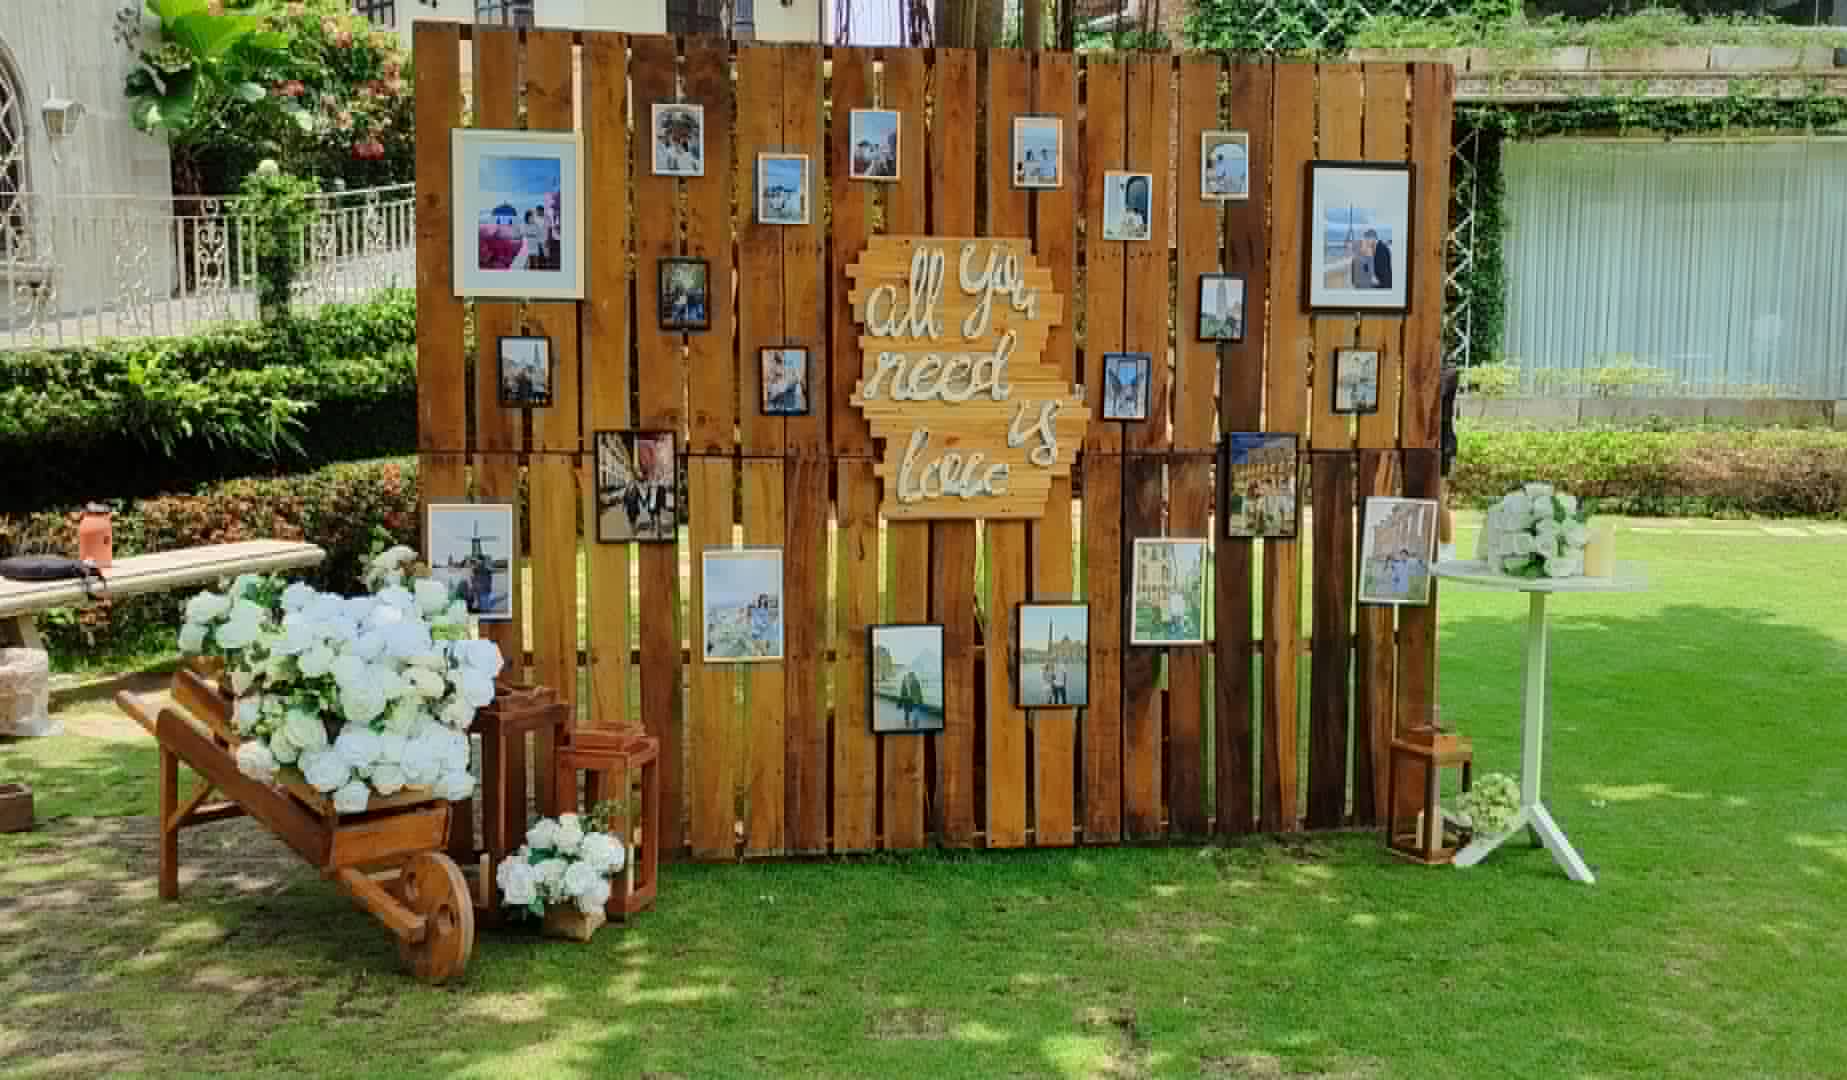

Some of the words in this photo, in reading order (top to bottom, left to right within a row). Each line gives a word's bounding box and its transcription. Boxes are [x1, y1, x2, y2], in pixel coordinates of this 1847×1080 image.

[865, 245, 945, 341] all
[863, 328, 1017, 404] need
[896, 424, 1009, 504] love
[1007, 398, 1063, 465] is
